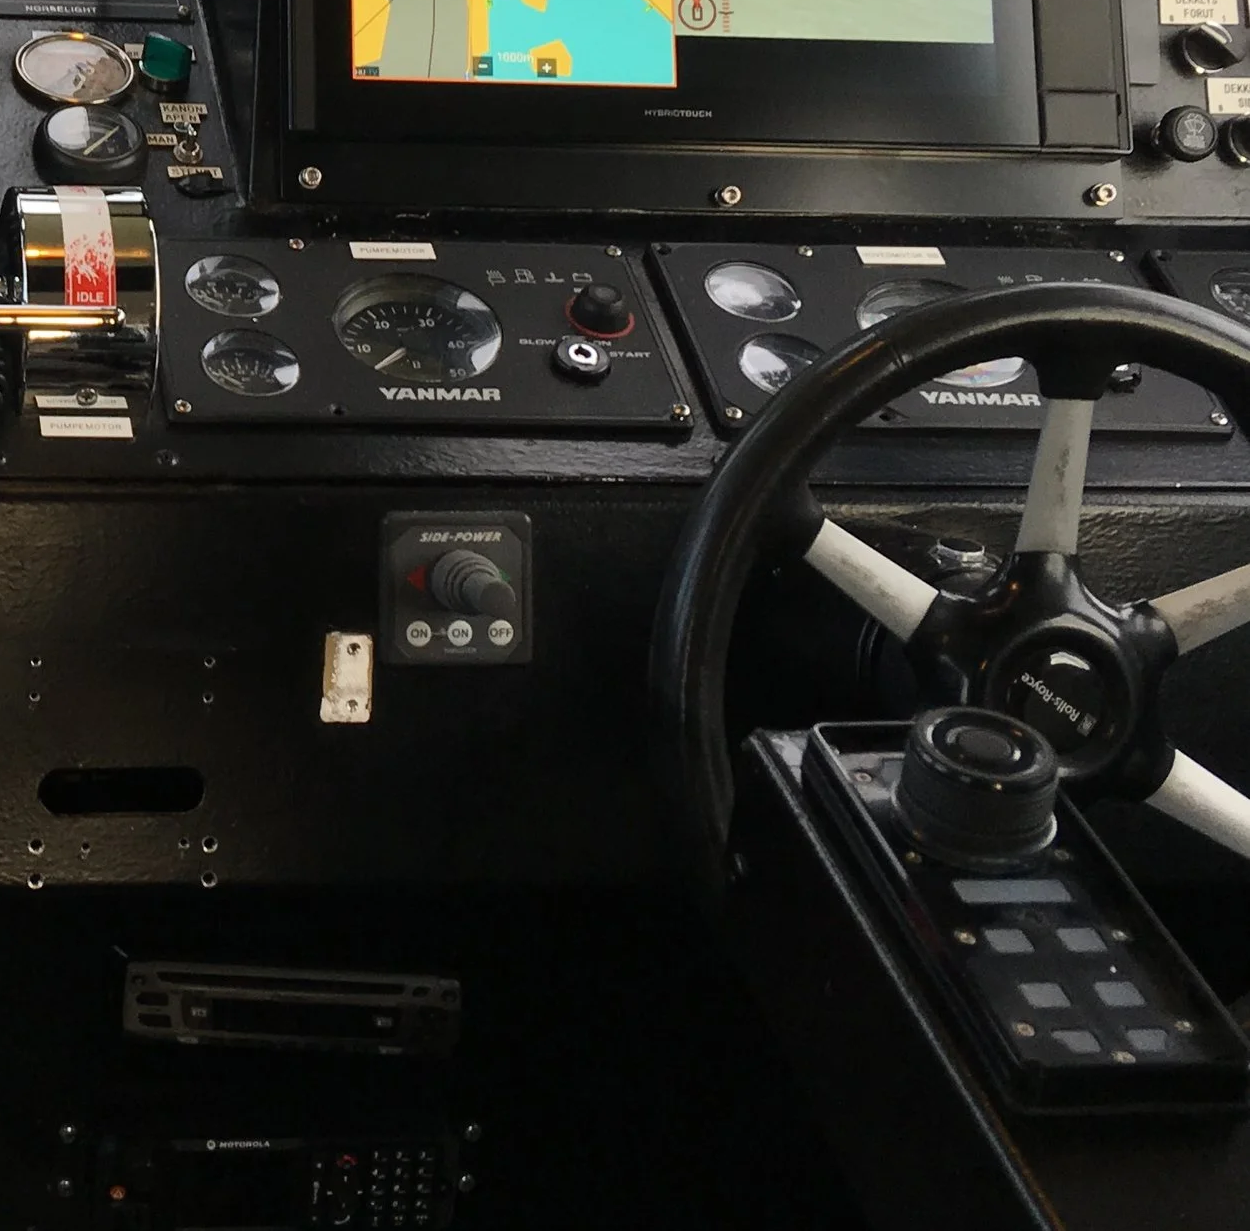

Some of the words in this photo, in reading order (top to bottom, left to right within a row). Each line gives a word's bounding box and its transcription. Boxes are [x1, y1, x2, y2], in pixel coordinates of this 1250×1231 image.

[1183, 8, 1215, 19] FORUT
[1224, 83, 1250, 94] DEKK
[162, 104, 203, 113] KANON
[644, 109, 713, 119] HYBRIDTOUCH
[148, 135, 175, 144] MAN
[76, 291, 105, 303] IDLE
[374, 320, 390, 330] 20
[418, 318, 435, 328] 30
[447, 340, 465, 350] 40
[519, 338, 556, 346] BLOW
[357, 343, 372, 354] 10
[609, 350, 651, 359] START
[378, 387, 501, 402] YANMAR
[918, 391, 1042, 407] YANMAR
[49, 422, 122, 431] PUMPEMOTOR
[419, 531, 503, 543] SIDE-POWER
[410, 628, 428, 639] ON
[451, 628, 469, 638] ON
[489, 627, 513, 638] OFF
[1021, 672, 1081, 722] Rolls-Royce
[219, 1140, 270, 1149] MOTOROLA
